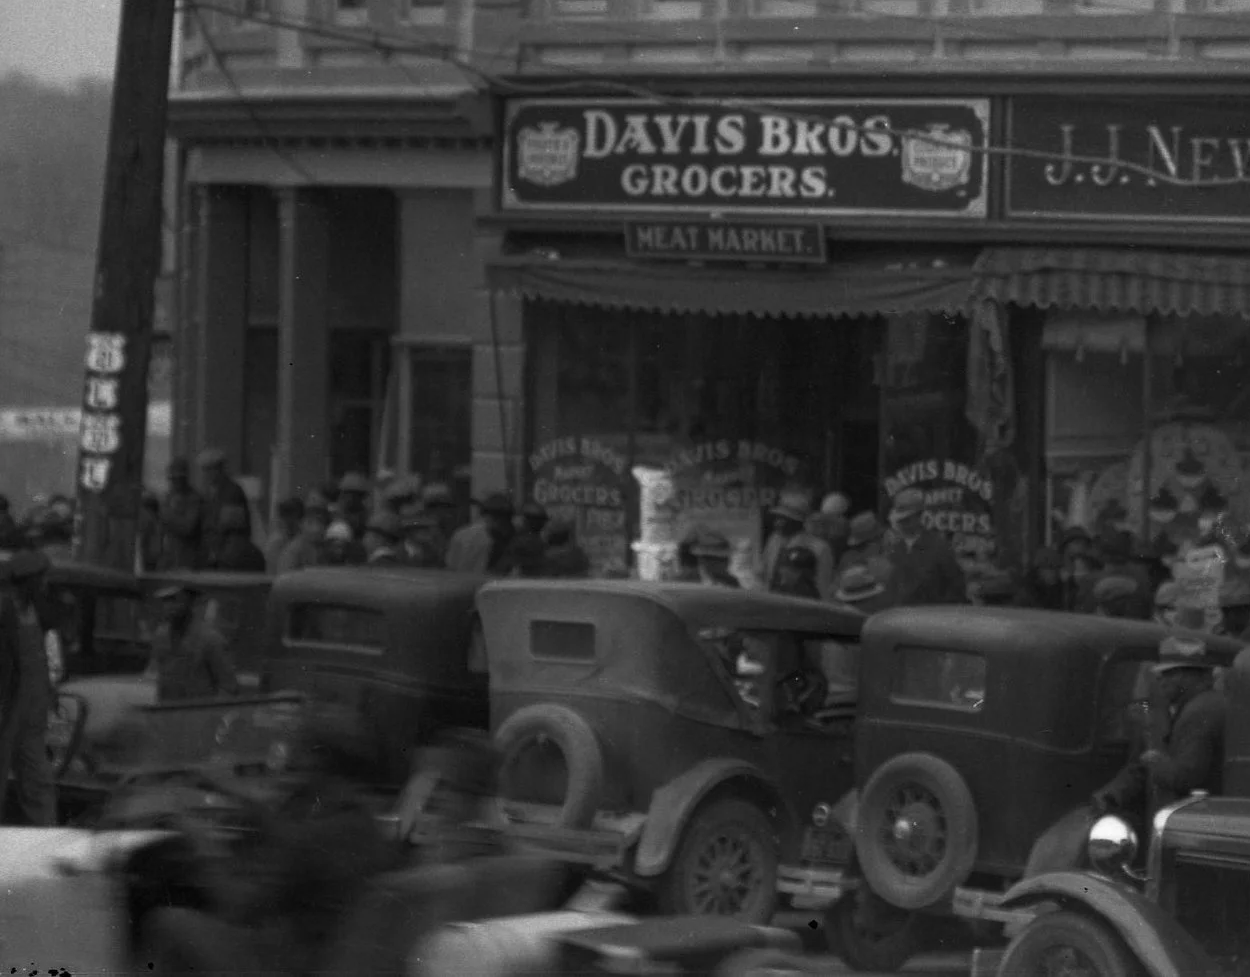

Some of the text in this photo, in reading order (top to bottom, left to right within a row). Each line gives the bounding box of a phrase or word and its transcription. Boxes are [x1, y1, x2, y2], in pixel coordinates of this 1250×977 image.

[582, 109, 745, 159] DAVIS
[758, 113, 898, 157] BROS.
[620, 164, 835, 199] GROCERS.
[636, 224, 699, 251] MEAT
[884, 458, 938, 498] DAVIS
